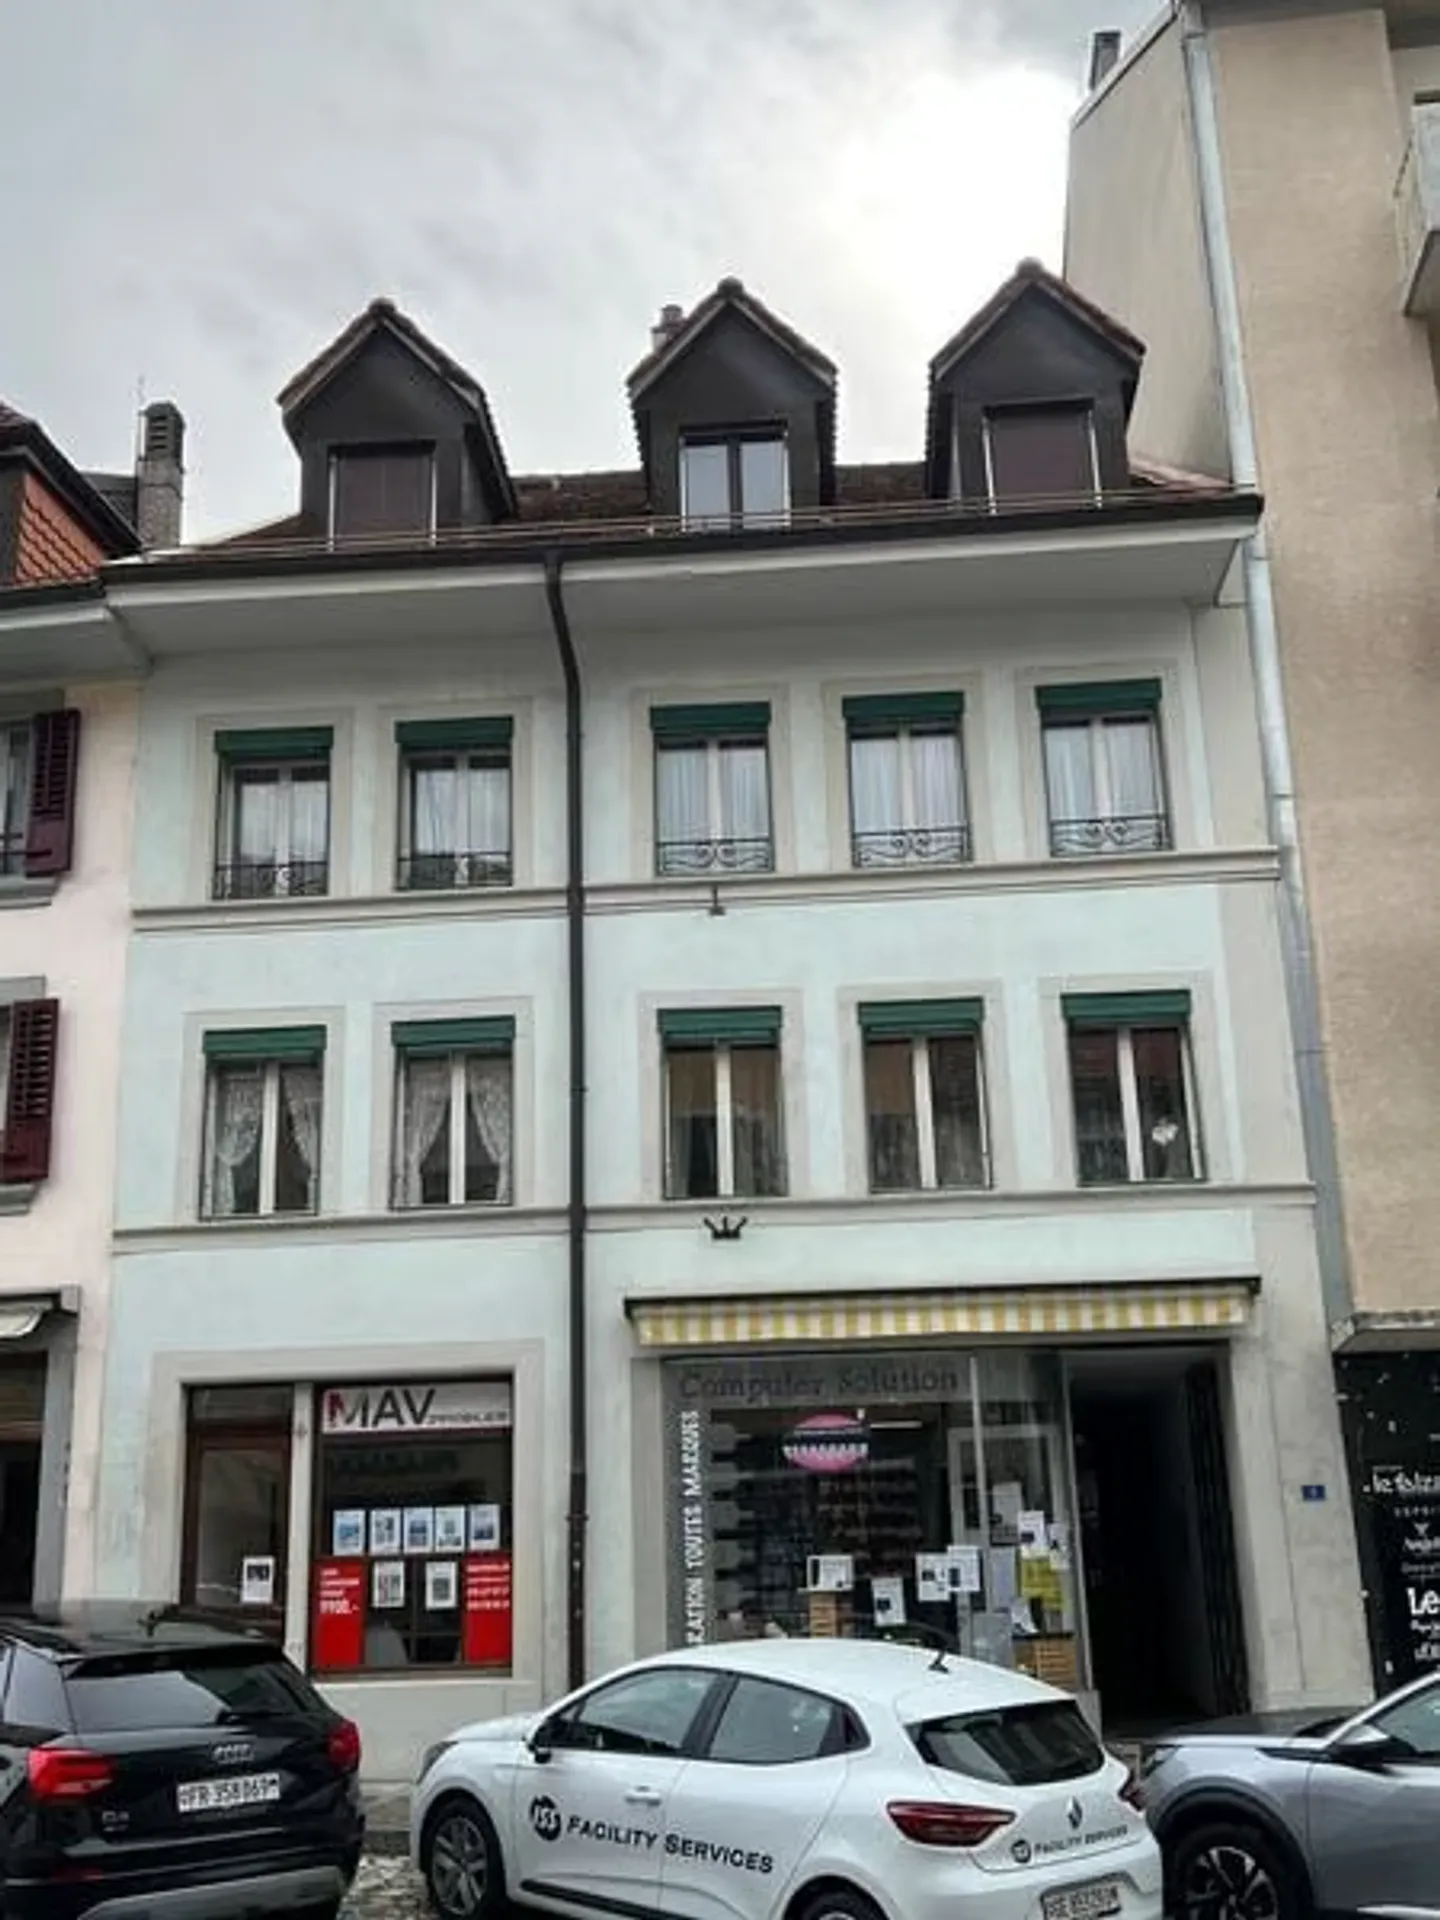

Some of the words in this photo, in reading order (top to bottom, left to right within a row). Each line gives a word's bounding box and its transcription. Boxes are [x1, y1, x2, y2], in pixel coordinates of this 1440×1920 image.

[838, 1366, 958, 1395] Solution
[327, 1388, 436, 1428] MAV
[566, 1815, 658, 1850] FACILITY
[664, 1832, 775, 1874] SERVICES
